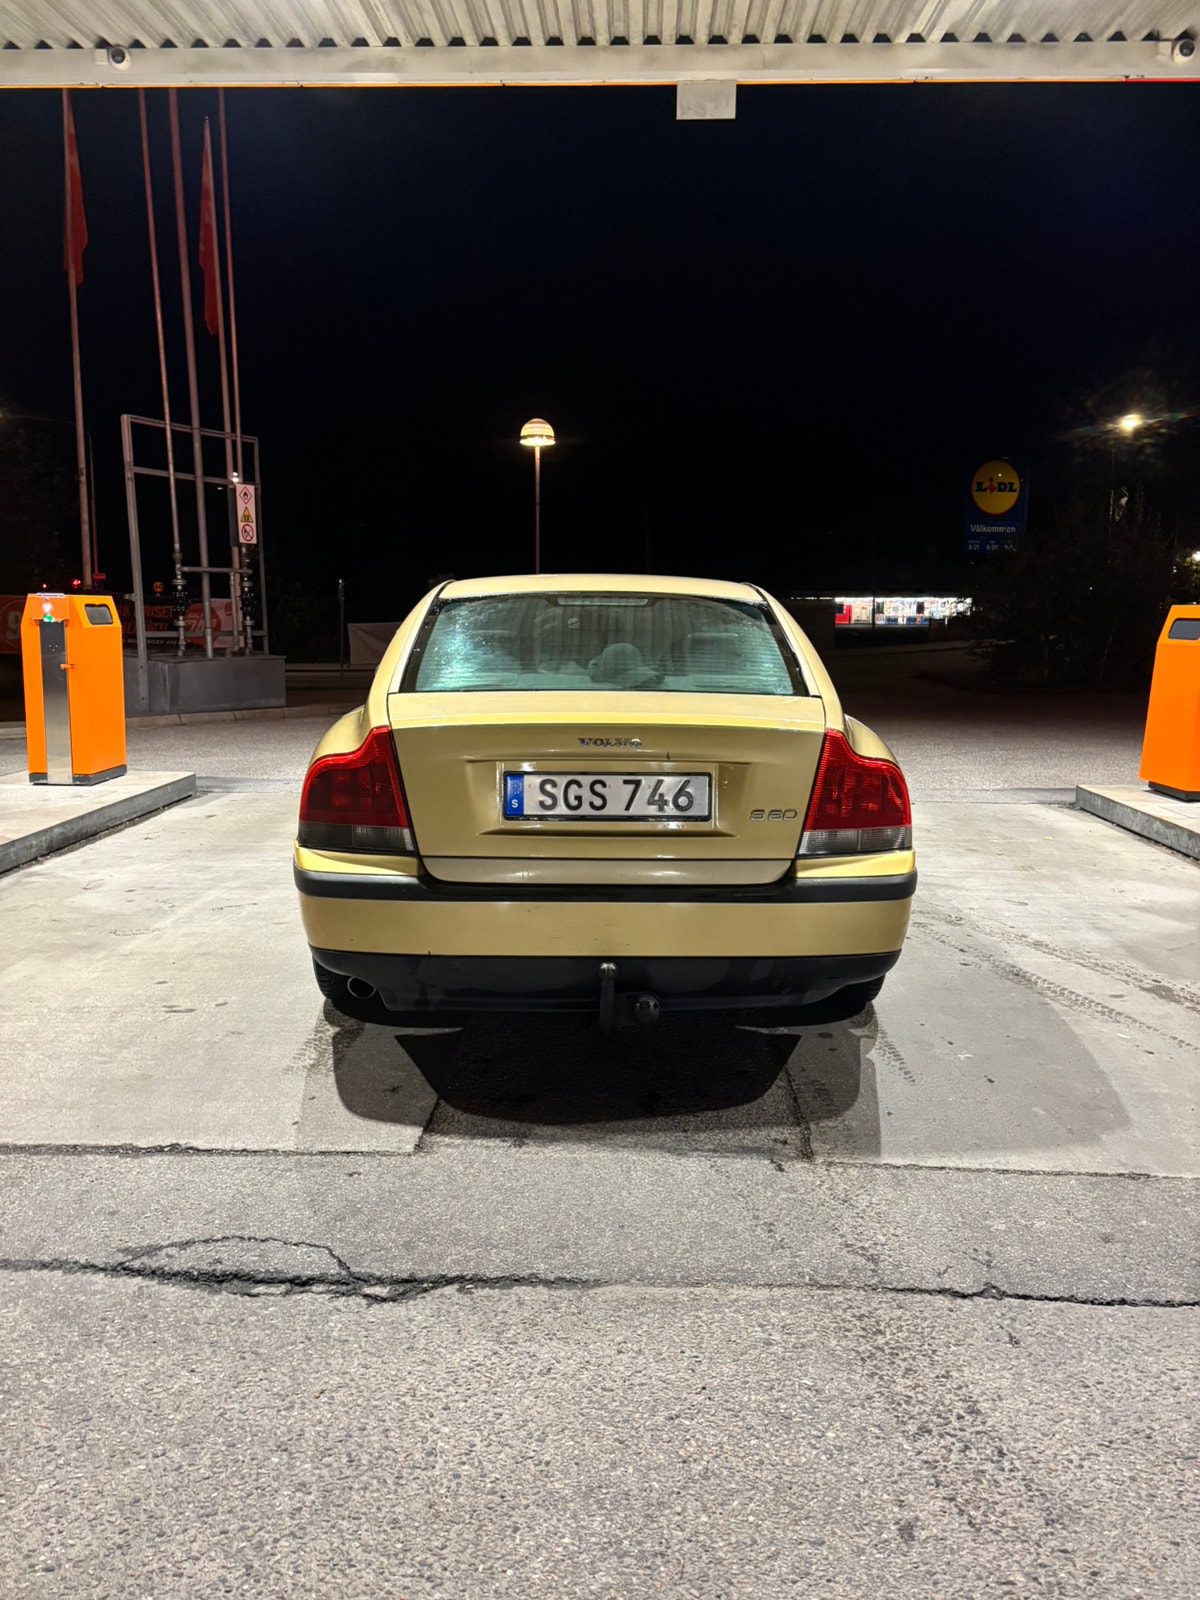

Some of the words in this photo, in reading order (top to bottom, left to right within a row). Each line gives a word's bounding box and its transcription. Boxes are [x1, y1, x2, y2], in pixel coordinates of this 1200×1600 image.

[970, 524, 1016, 533] Välkommen
[578, 737, 642, 748] VOLVO
[539, 779, 607, 811] SGS
[622, 779, 694, 812] 746
[511, 799, 519, 808] S
